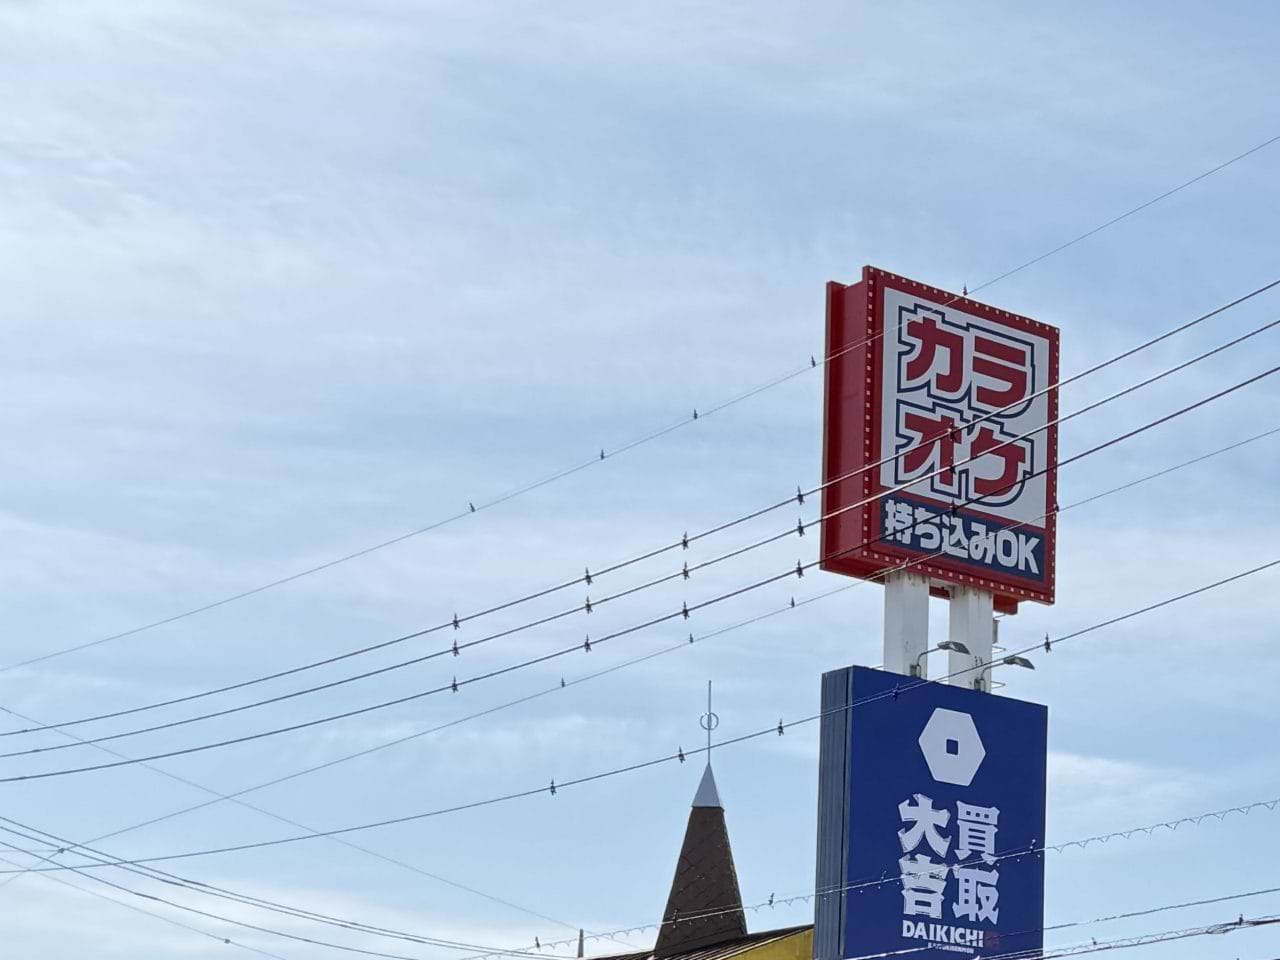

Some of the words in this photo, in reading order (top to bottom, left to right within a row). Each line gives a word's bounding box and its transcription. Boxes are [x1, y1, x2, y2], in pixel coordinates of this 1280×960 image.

[903, 311, 1030, 413] カラ
[900, 408, 1029, 501] オケ
[884, 498, 1041, 574] 持ち込みOK
[898, 793, 952, 919] 大吉
[953, 801, 1001, 925] 買取
[902, 919, 984, 948] DAIKICHI
